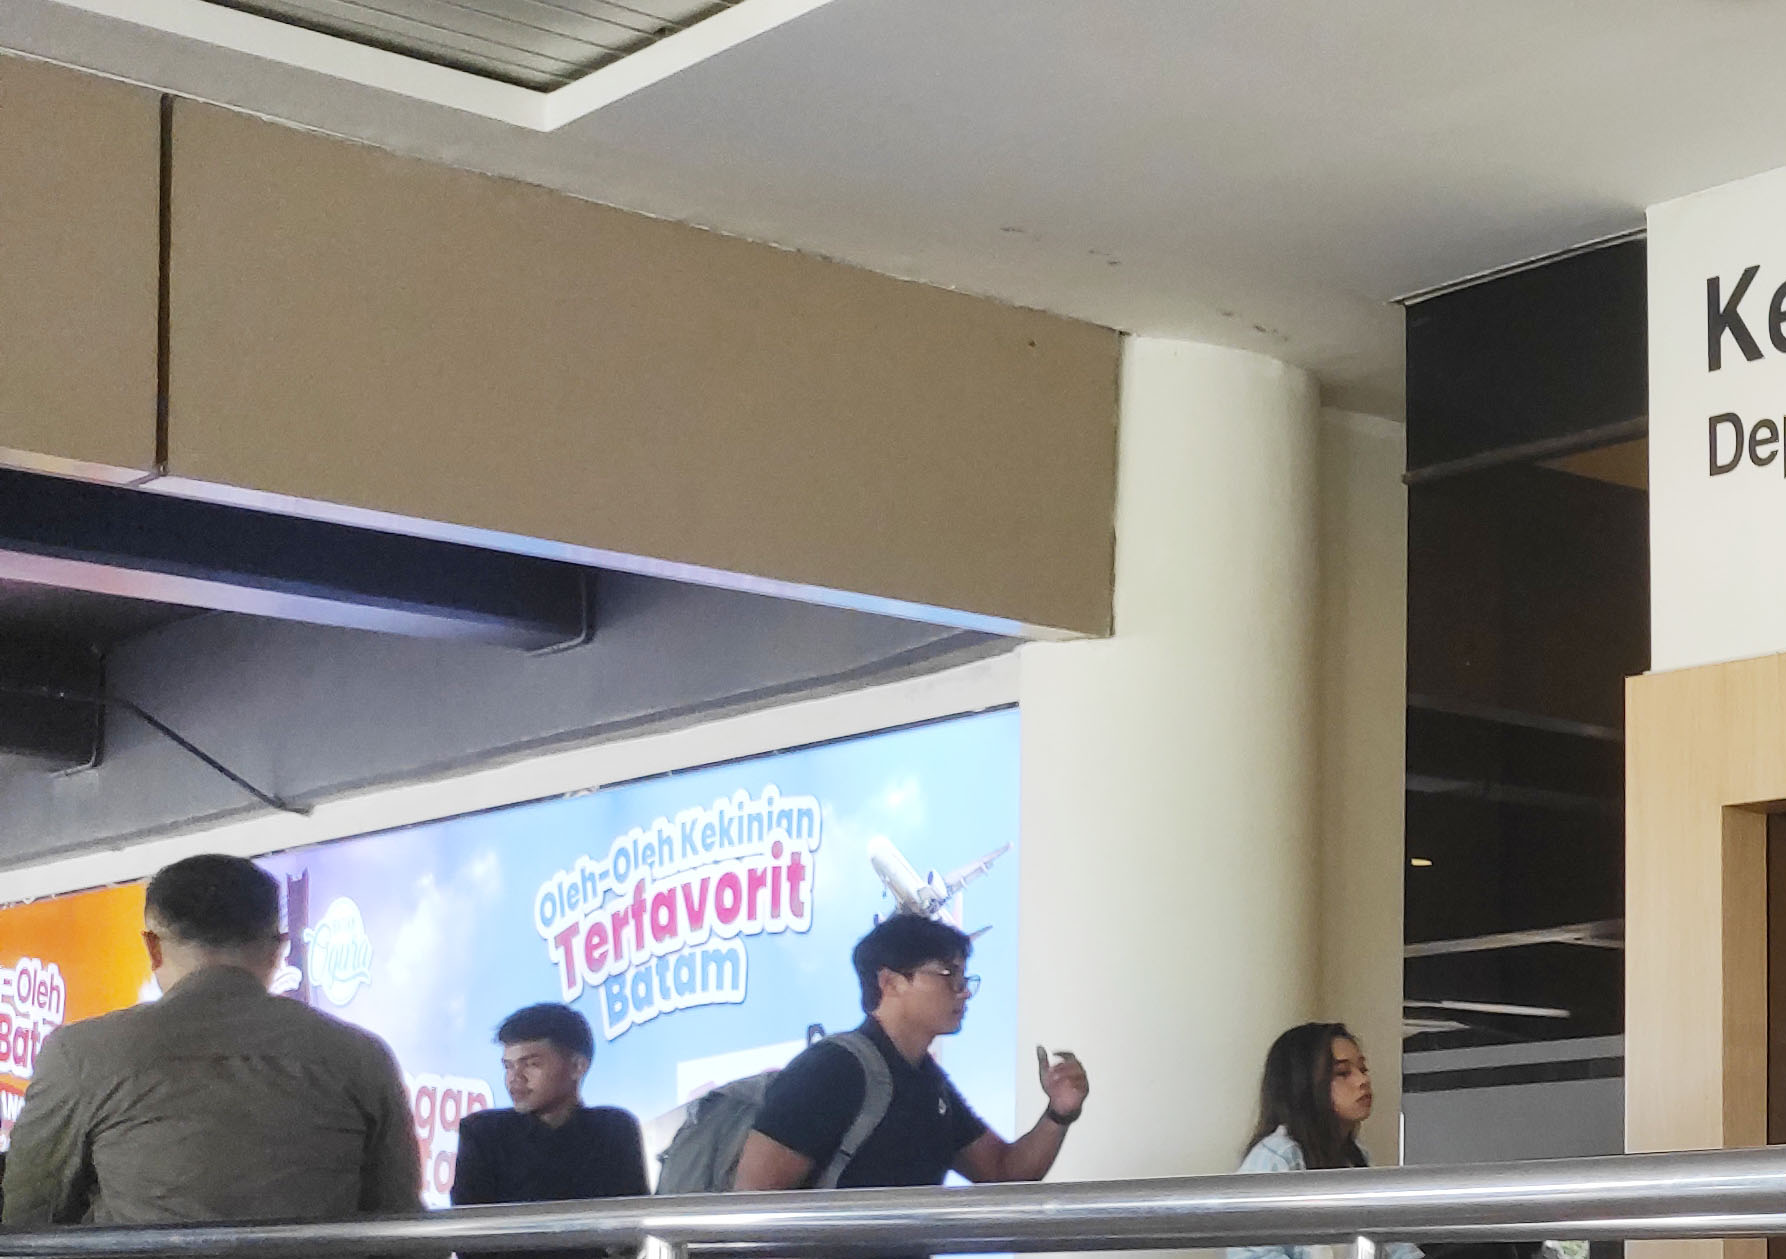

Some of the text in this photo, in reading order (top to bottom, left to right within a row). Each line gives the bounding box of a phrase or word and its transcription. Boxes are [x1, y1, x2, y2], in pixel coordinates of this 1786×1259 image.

[540, 797, 815, 927] Oleh-Oleh Kekinian
[554, 841, 807, 990] Terfavorit
[0, 1014, 49, 1067] Bat
[602, 948, 740, 1028] Batam
